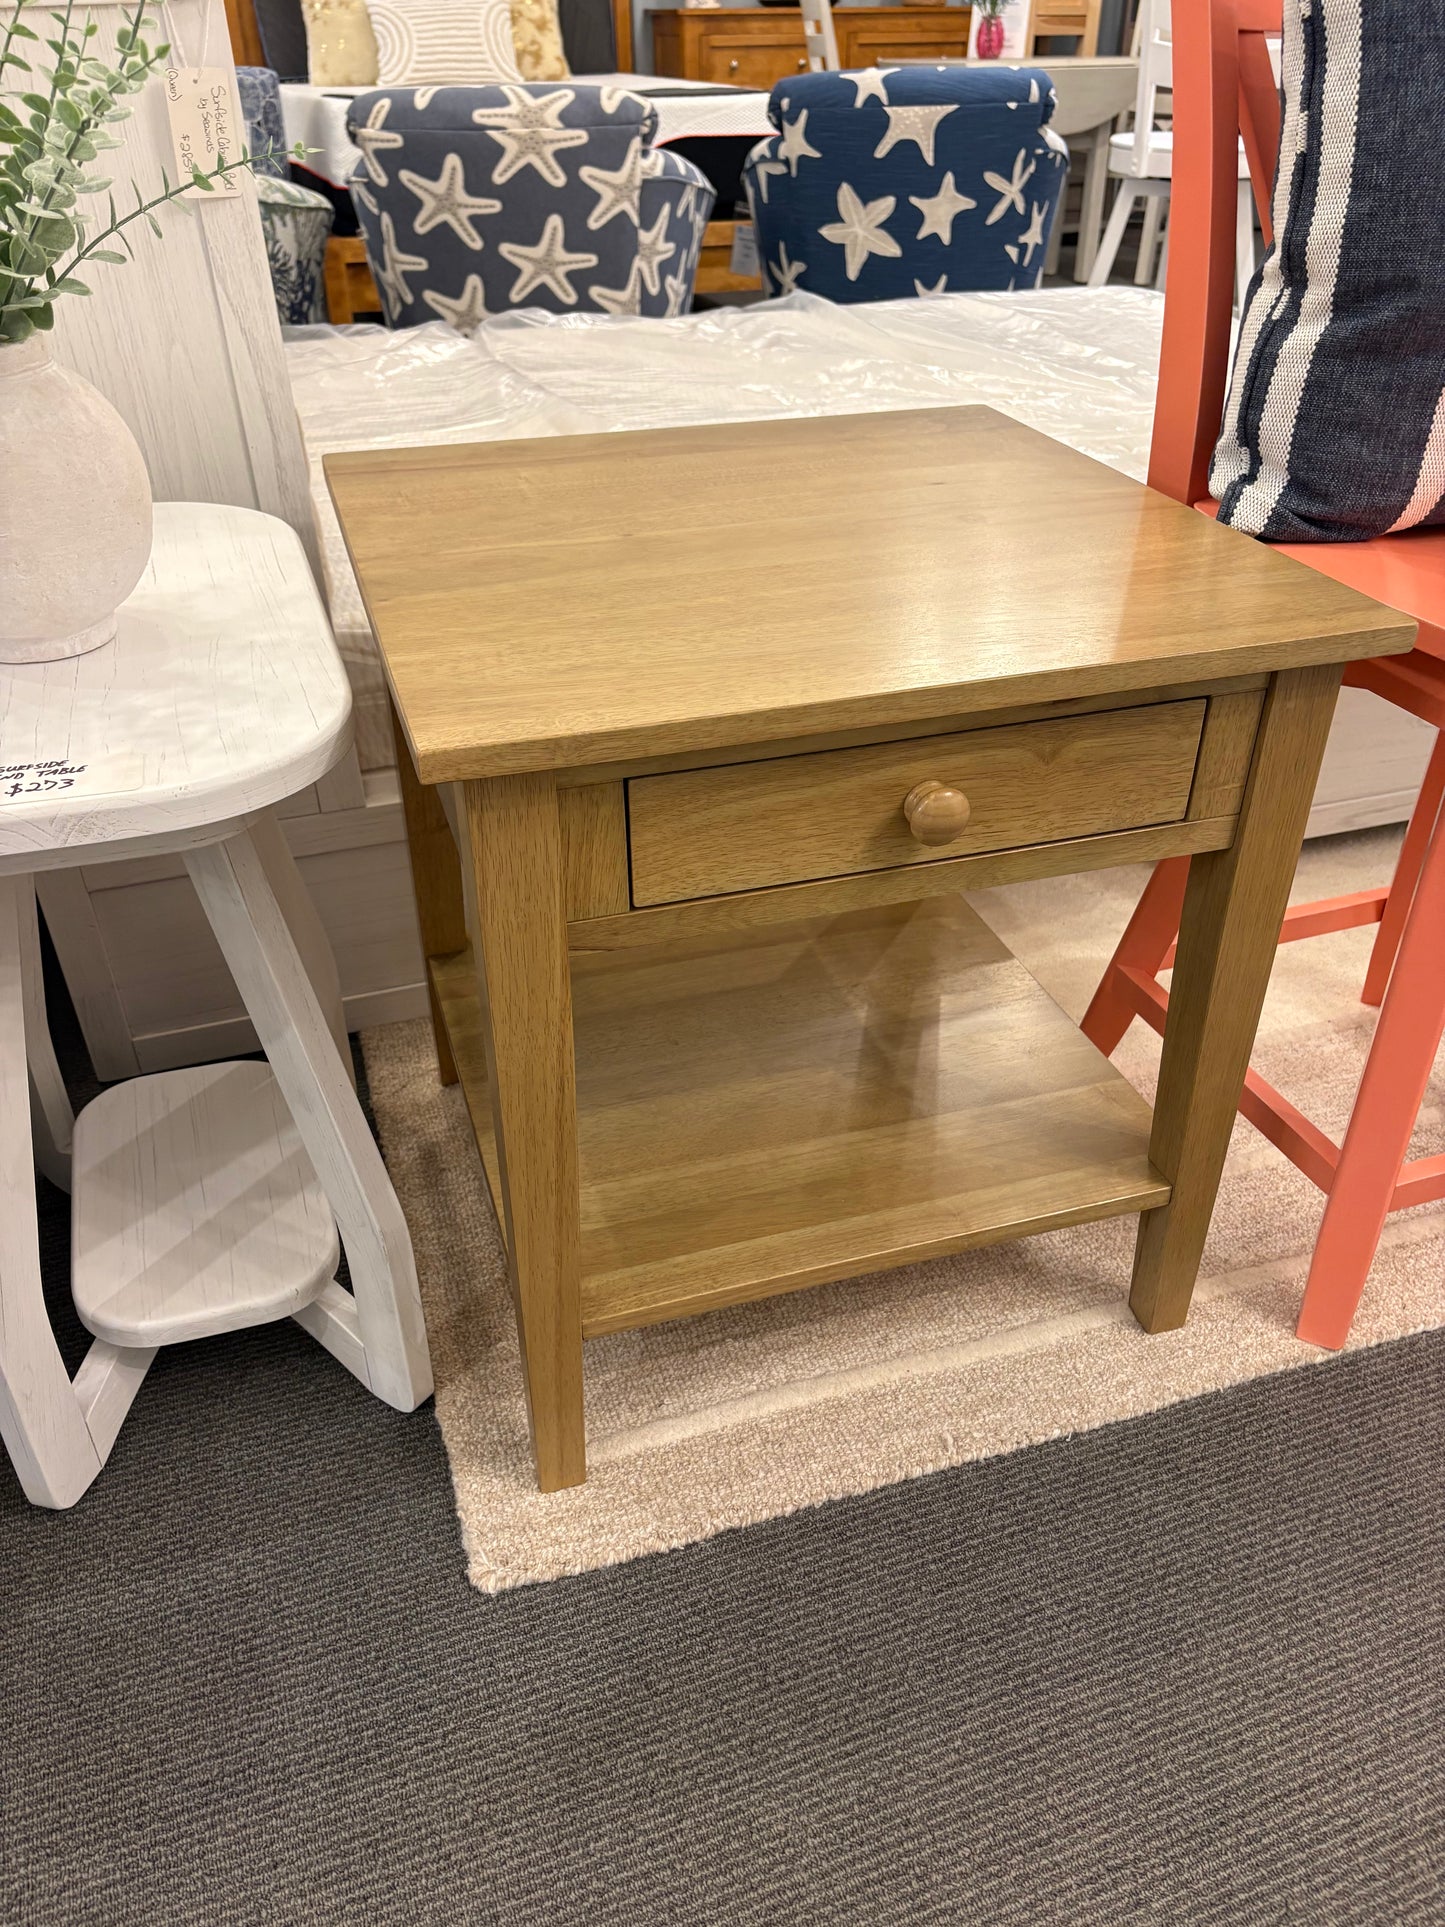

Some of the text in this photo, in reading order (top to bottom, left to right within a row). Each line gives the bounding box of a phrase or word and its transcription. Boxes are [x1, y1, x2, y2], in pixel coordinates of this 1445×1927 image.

[165, 68, 182, 101] (Queen)
[197, 98, 214, 153] by Seawinds
[211, 85, 226, 136] Surfside
[180, 133, 194, 174] $2859
[0, 759, 70, 773] SURFSIDE
[0, 764, 89, 781] ND TABLE
[4, 778, 75, 797] $273
